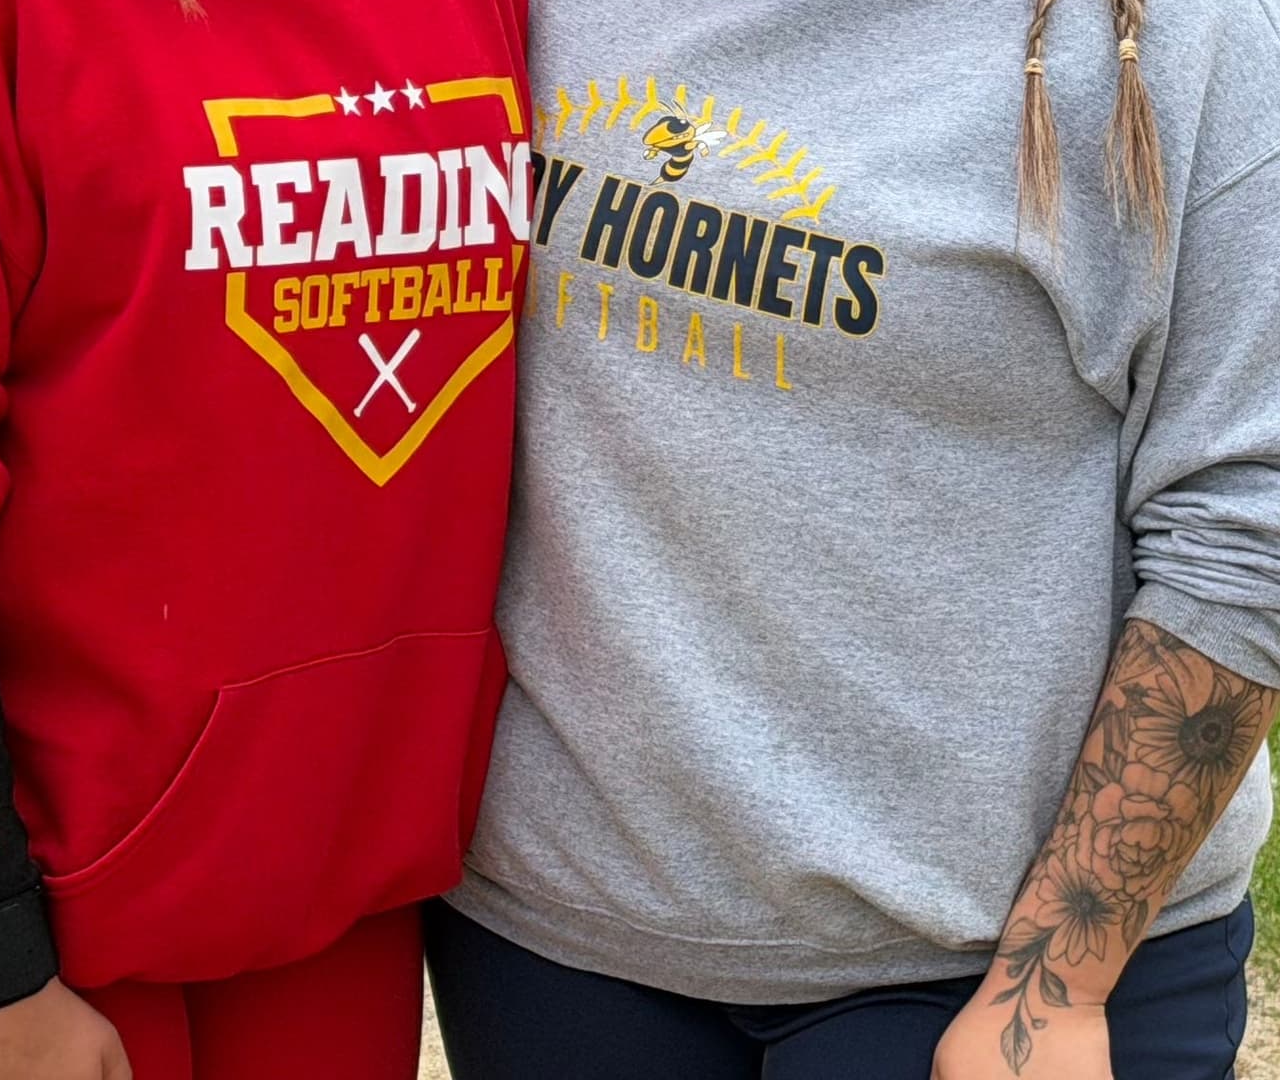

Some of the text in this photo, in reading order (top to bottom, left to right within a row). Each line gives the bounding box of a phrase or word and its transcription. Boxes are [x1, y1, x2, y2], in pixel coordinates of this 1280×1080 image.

[273, 257, 513, 334] SOFTBALL
[579, 172, 888, 338] HORNETS
[528, 264, 794, 392] FTBALL
